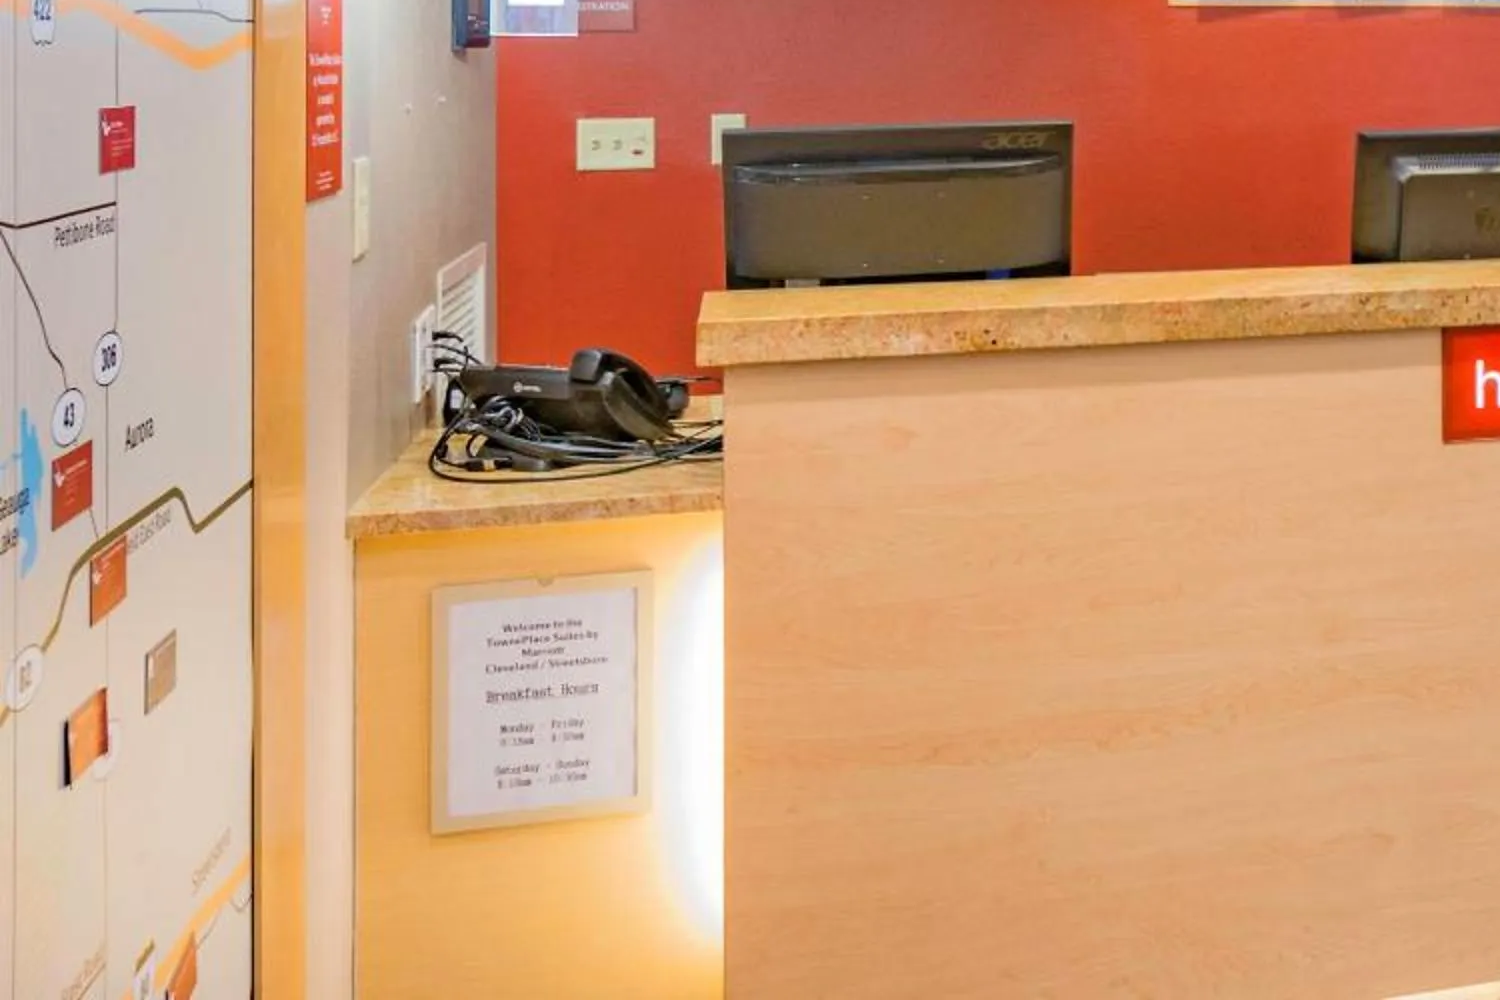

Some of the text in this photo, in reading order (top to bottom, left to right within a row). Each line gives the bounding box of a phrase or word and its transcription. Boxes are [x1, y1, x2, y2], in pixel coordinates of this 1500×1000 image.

[982, 131, 1057, 151] acer
[63, 402, 75, 428] 43
[125, 417, 154, 453] Aurora
[503, 622, 551, 633] Welcome
[486, 686, 553, 704] Breakfast
